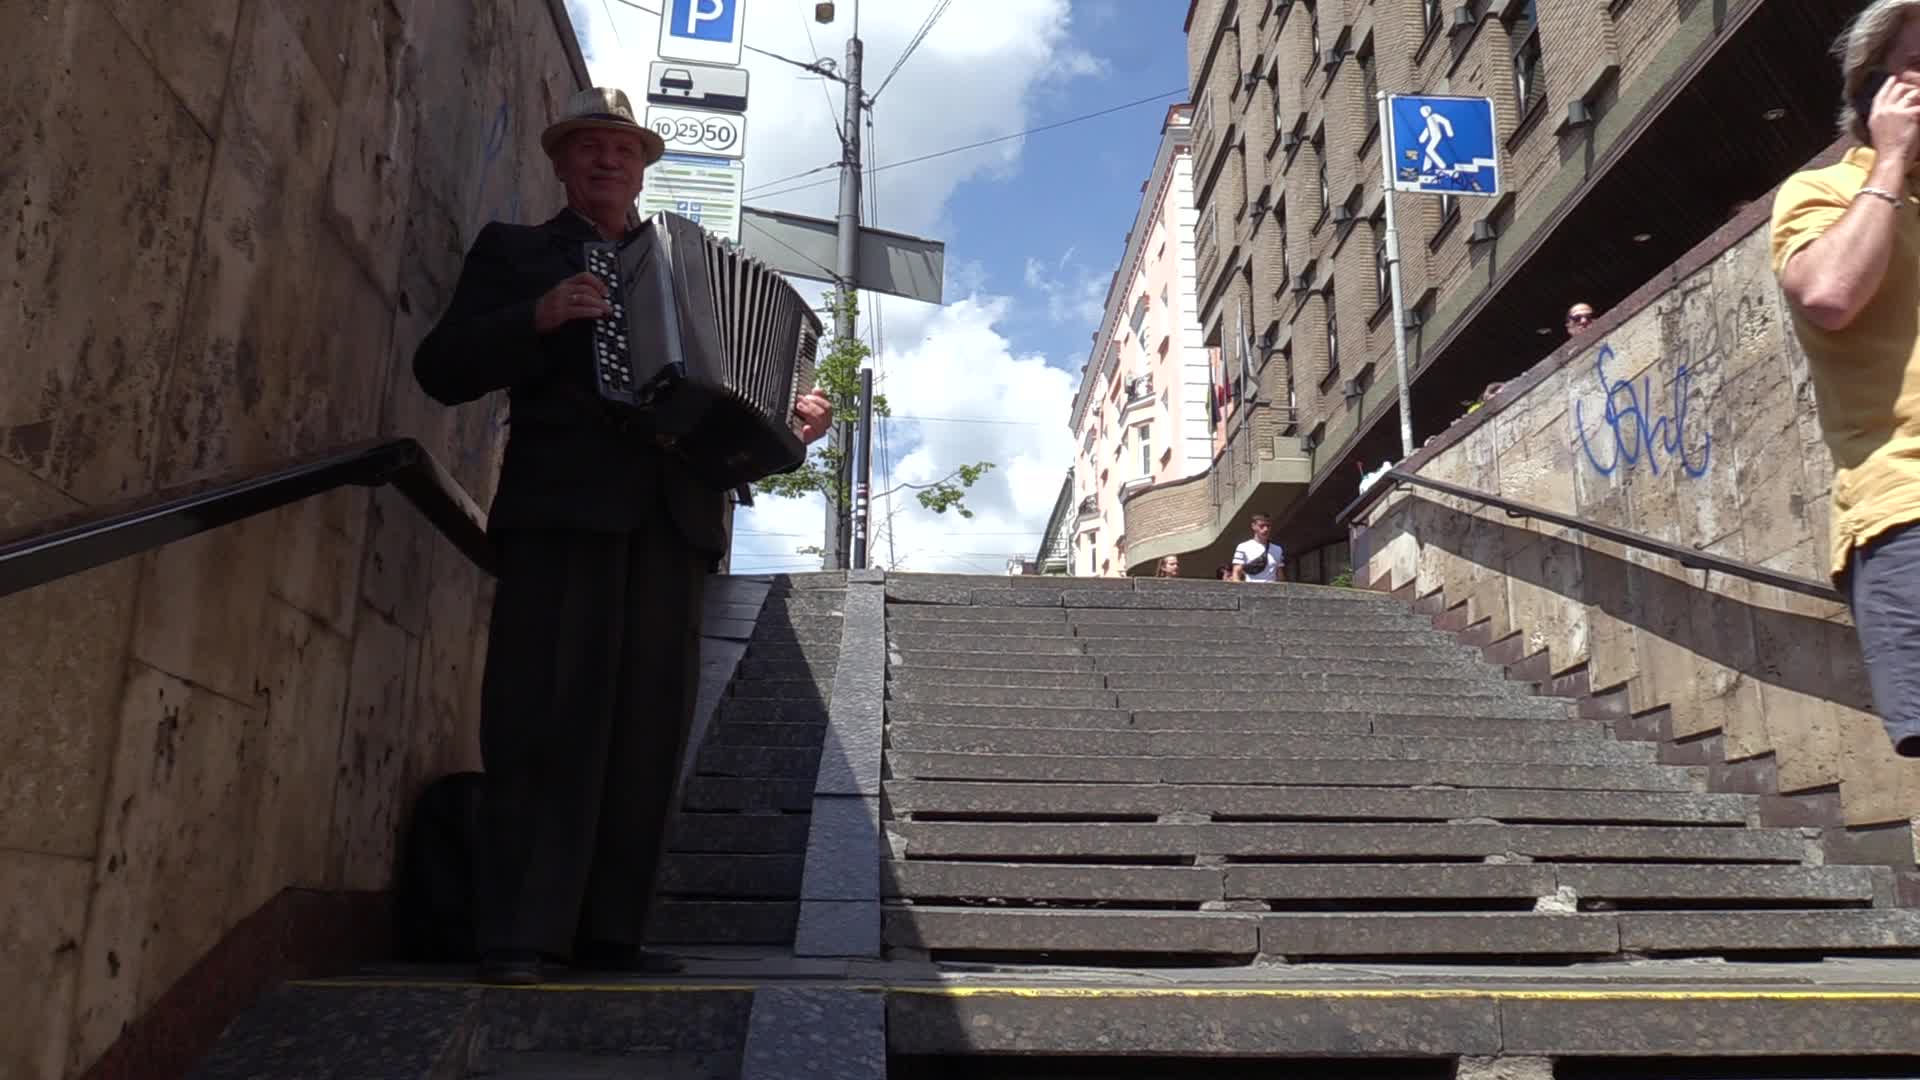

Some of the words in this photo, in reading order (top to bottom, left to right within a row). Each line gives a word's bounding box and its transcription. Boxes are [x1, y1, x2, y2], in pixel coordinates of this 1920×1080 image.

[687, 0, 724, 34] P
[656, 122, 671, 135] 10
[678, 123, 699, 138] 25
[705, 124, 731, 143] 50
